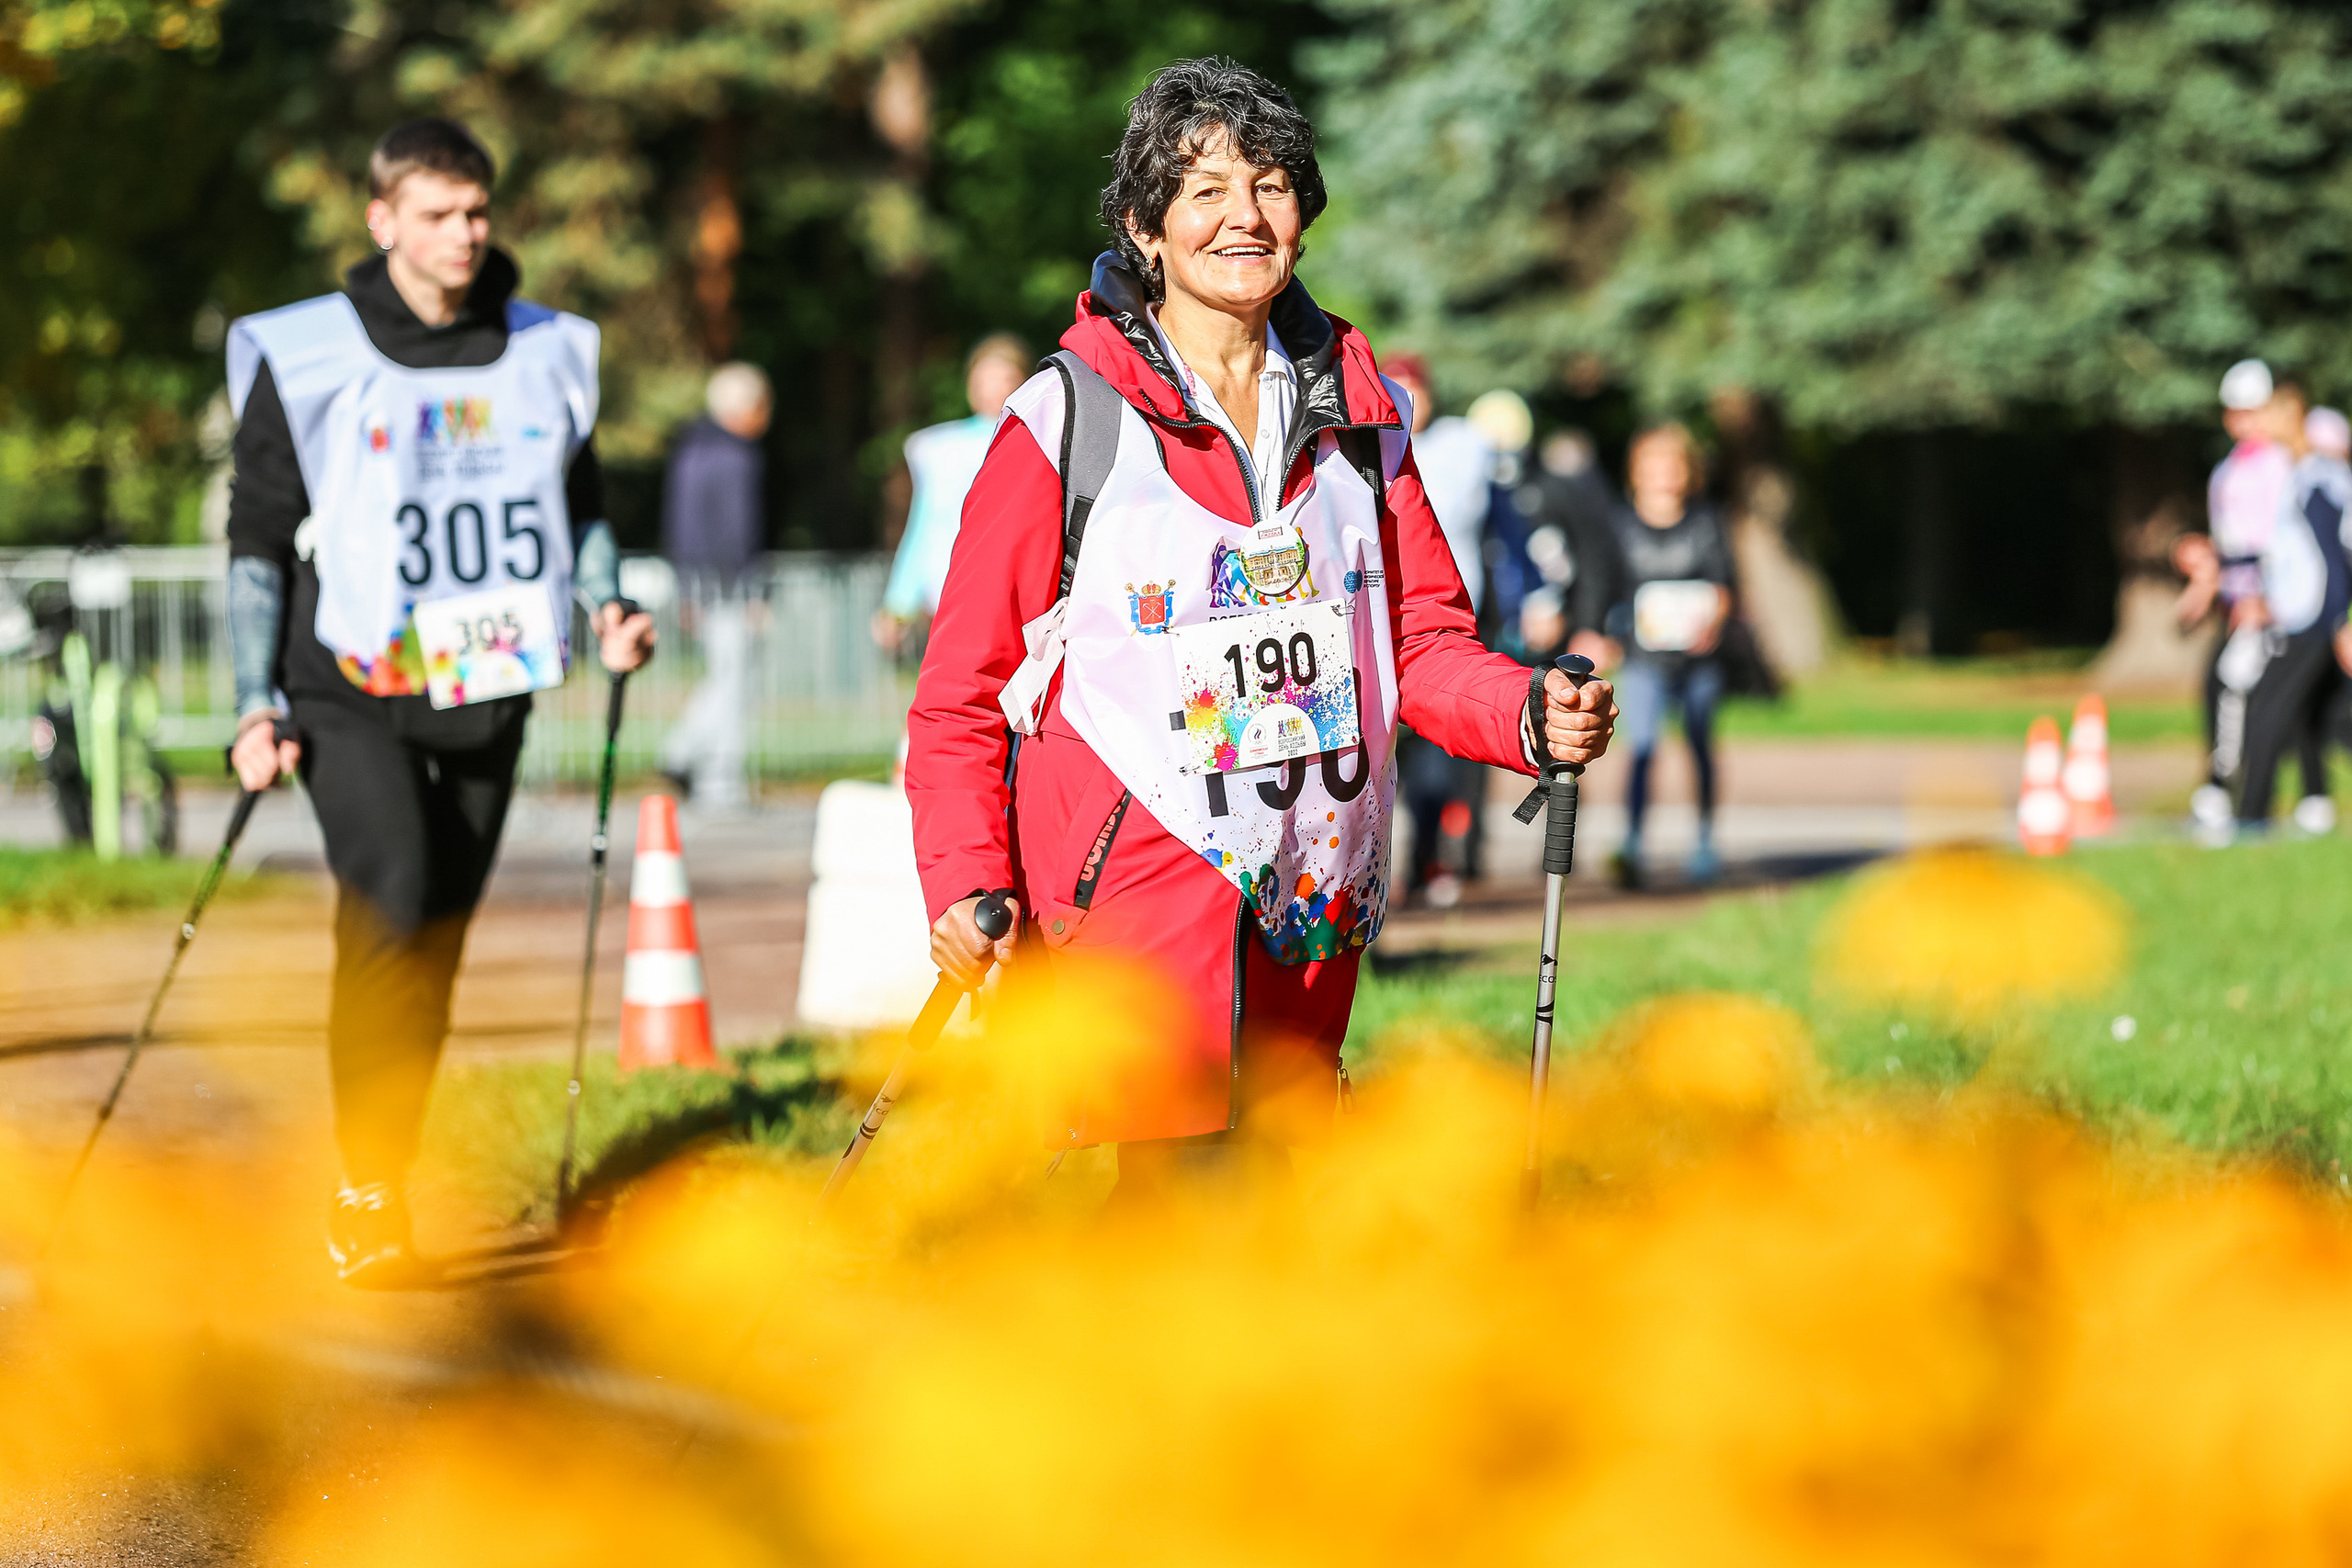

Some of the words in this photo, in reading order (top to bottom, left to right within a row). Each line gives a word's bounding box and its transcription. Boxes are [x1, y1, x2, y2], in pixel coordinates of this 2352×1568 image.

[396, 500, 544, 585] 305
[457, 612, 523, 654] 305
[1224, 632, 1317, 698] 190
